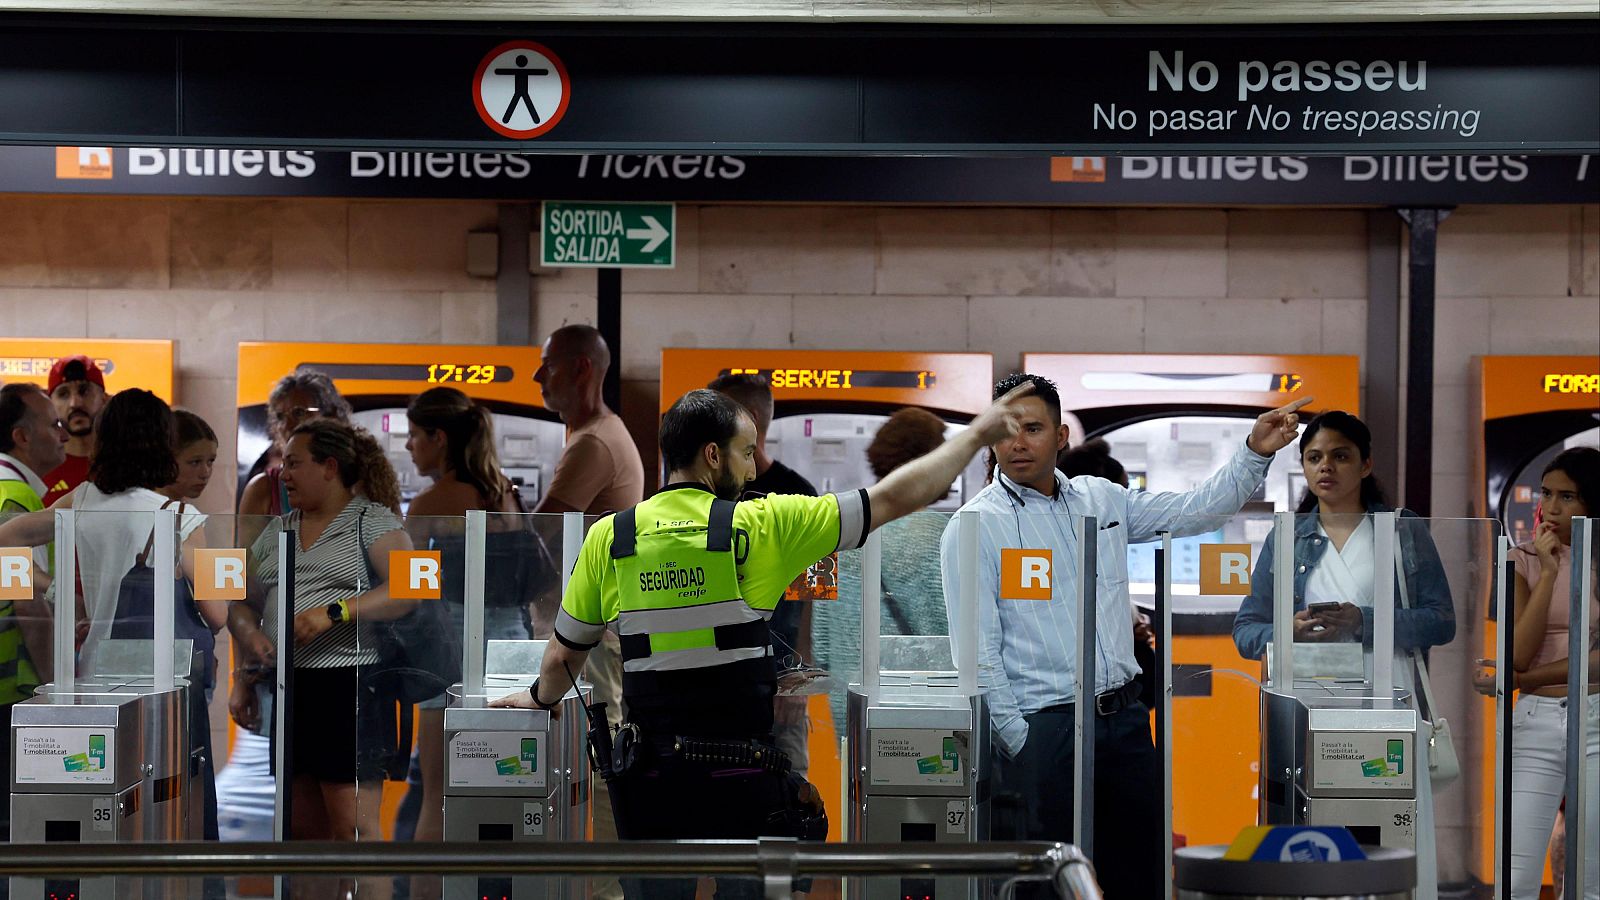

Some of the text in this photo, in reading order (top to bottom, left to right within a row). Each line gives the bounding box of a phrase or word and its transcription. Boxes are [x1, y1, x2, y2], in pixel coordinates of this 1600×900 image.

[1148, 50, 1427, 102] No passeu
[1093, 103, 1481, 137] No pasar No trespassing
[550, 209, 624, 236] SORTIDA
[553, 235, 620, 262] SALIDA
[427, 364, 495, 384] 17:29
[771, 369, 853, 389] SERVEI
[0, 555, 31, 588] R
[214, 557, 245, 589] R
[409, 557, 439, 589] R
[639, 566, 705, 593] SEGURIDAD
[1021, 556, 1050, 589] R
[1220, 552, 1250, 585] R
[678, 587, 707, 599] renfe
[94, 808, 111, 821] 35
[524, 812, 541, 826] 36
[947, 811, 965, 824] 37
